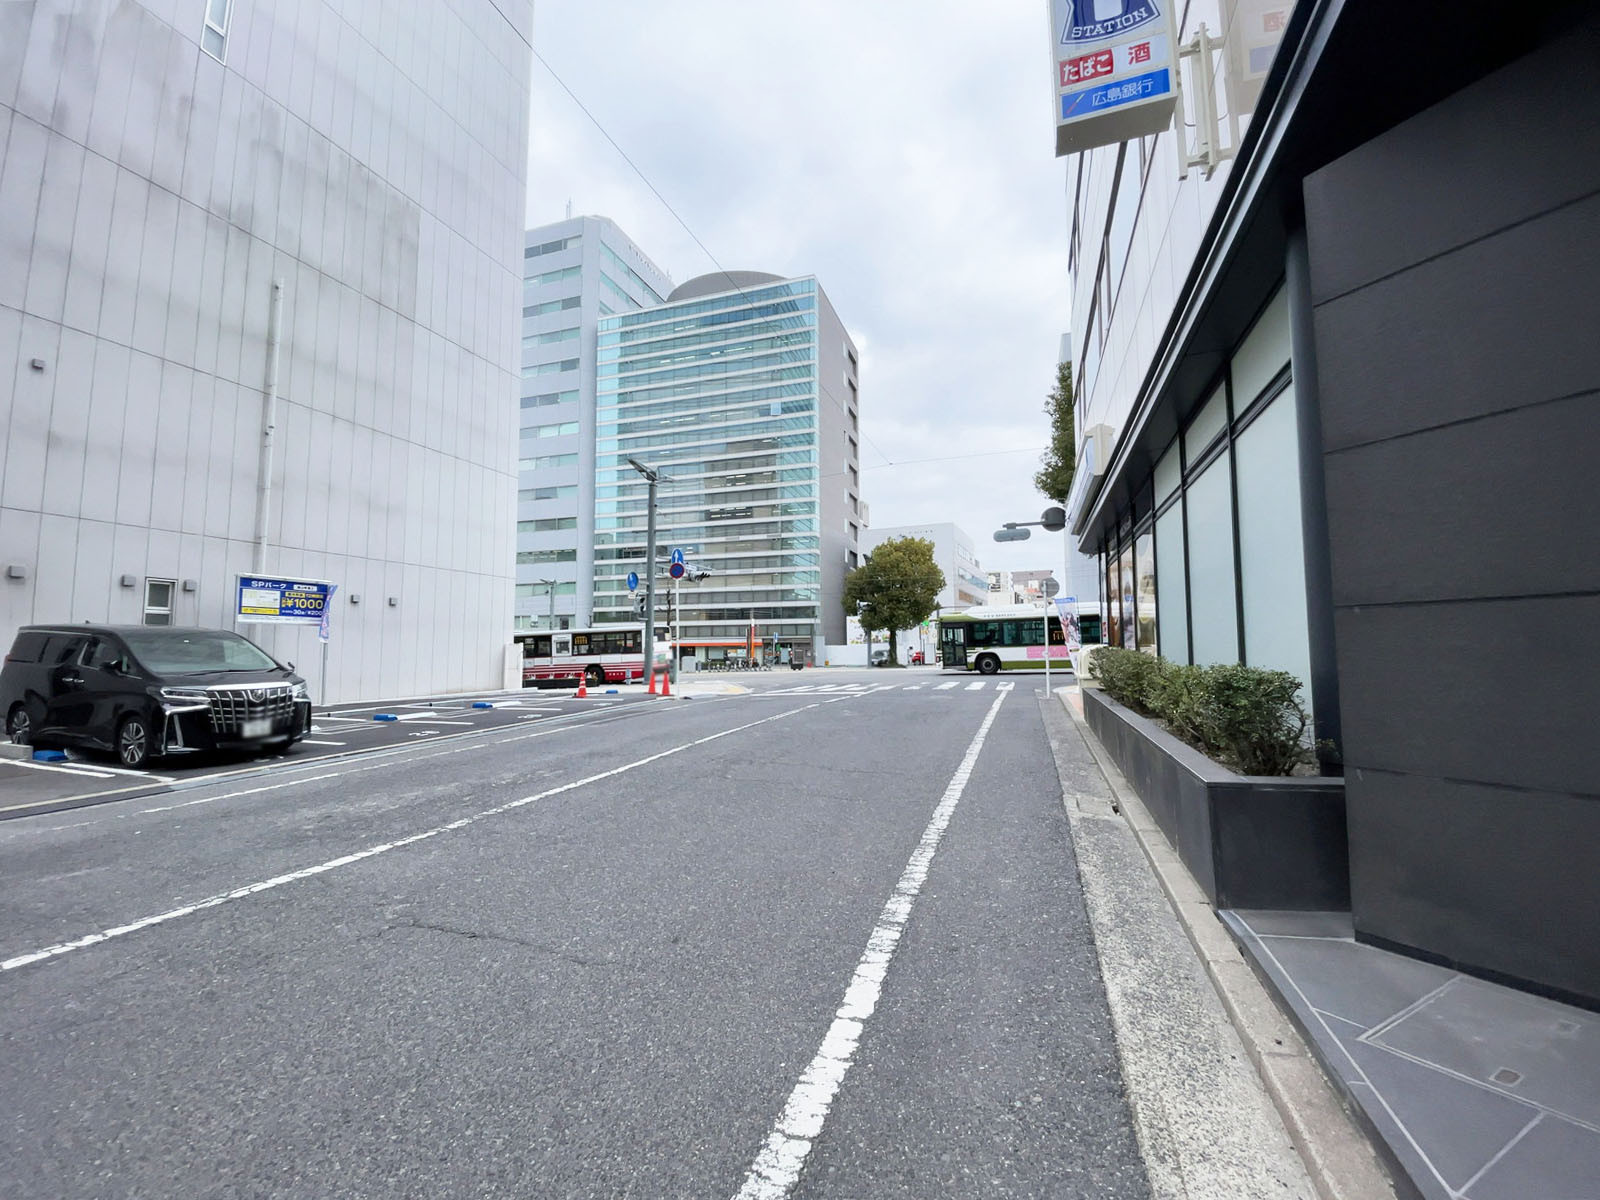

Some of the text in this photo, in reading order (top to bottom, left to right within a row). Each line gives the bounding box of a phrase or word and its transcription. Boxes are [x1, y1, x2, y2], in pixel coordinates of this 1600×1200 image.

[1071, 7, 1149, 38] STATION
[1063, 41, 1151, 82] たばこ 酒
[1092, 78, 1154, 107] 広島銀行
[251, 580, 287, 589] SPパーク
